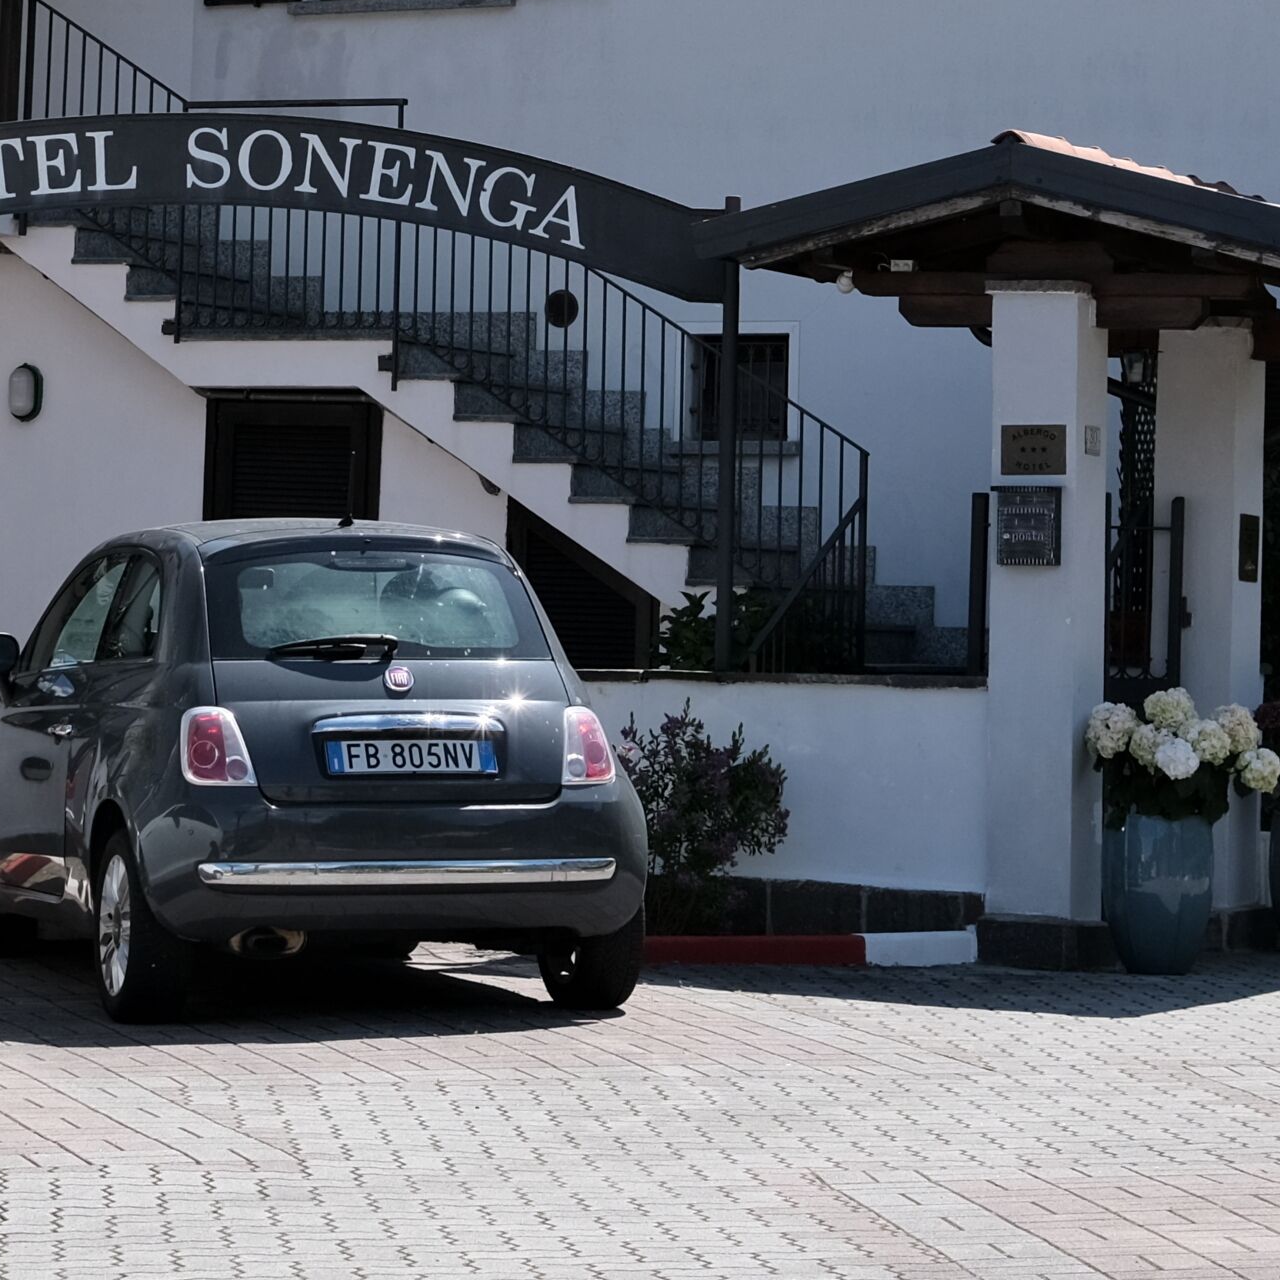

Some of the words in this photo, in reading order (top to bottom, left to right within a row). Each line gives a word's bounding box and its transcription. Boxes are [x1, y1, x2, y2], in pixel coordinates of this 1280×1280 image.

[186, 127, 586, 250] SONENGA
[1011, 427, 1057, 442] ALBERGO
[1015, 461, 1052, 471] HOTEL
[390, 671, 409, 686] FIAT
[346, 743, 380, 770] FB
[391, 743, 473, 770] 805NV
